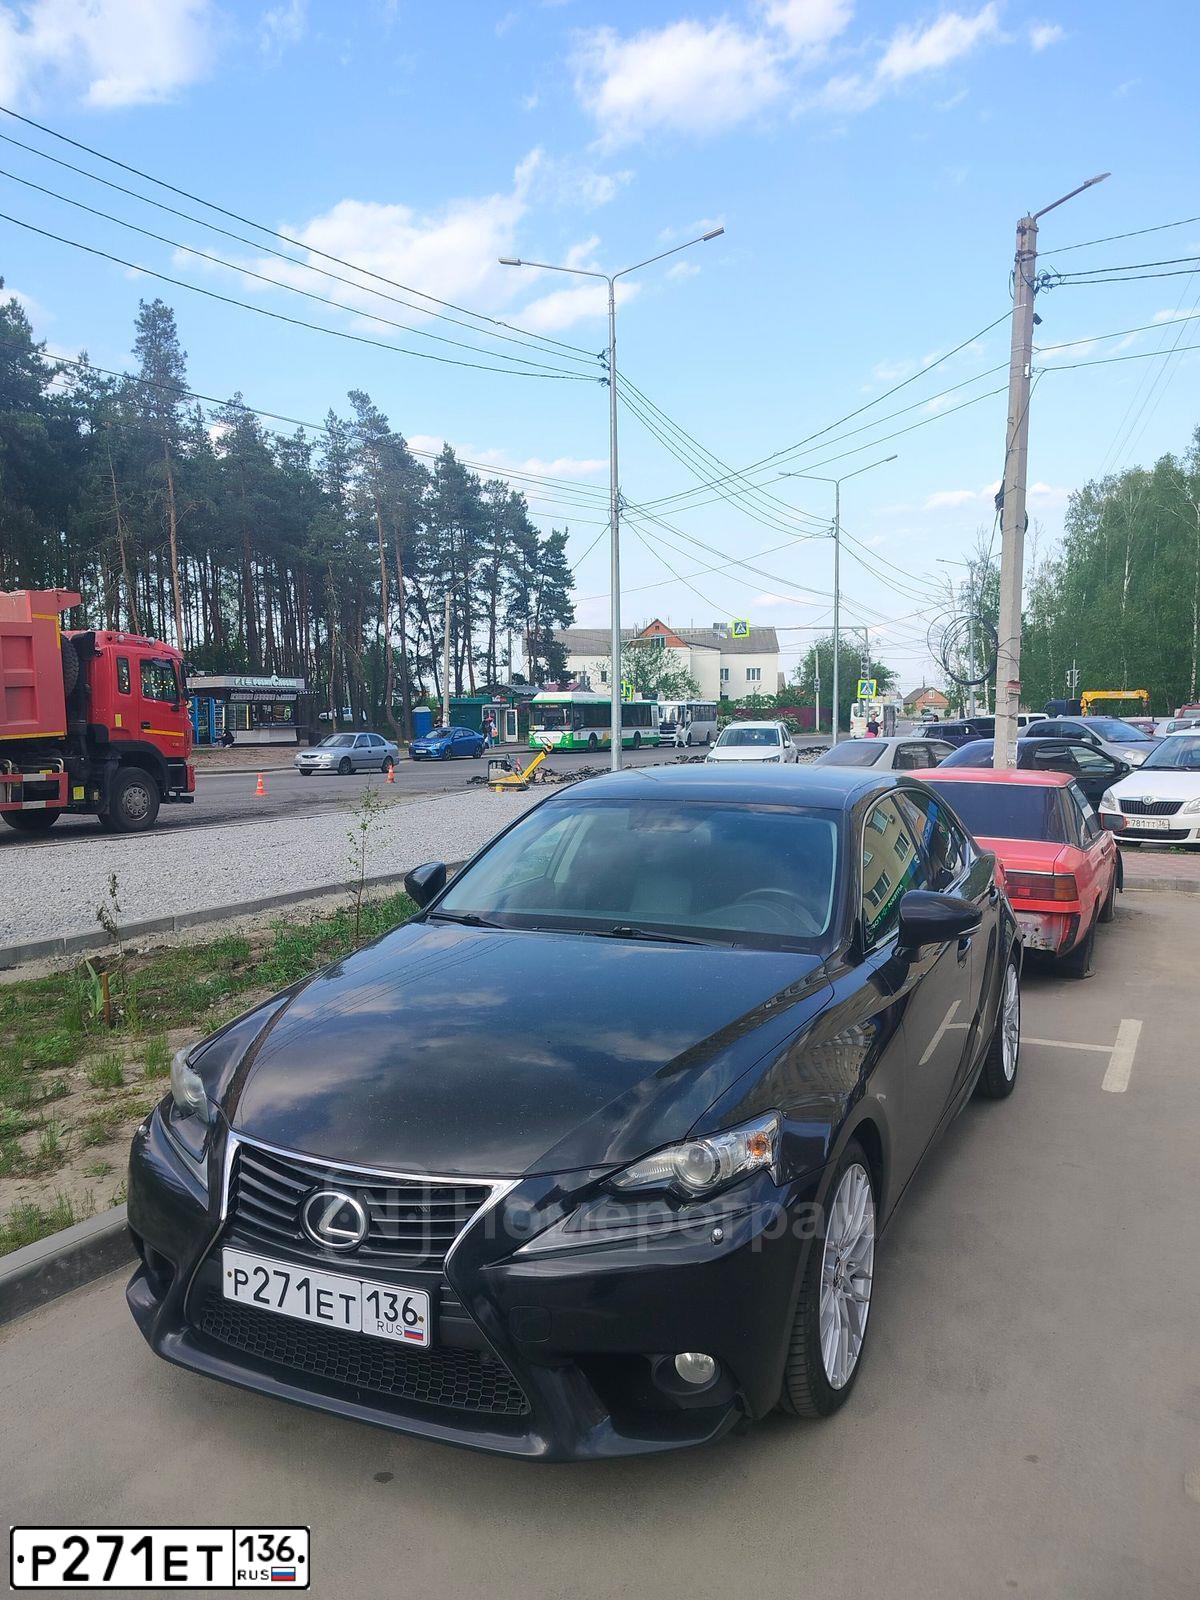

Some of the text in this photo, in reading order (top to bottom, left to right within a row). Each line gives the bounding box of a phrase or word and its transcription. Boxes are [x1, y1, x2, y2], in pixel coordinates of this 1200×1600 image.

[233, 1266, 419, 1327] Р271ЕТ 136
[376, 1320, 404, 1336] RUS
